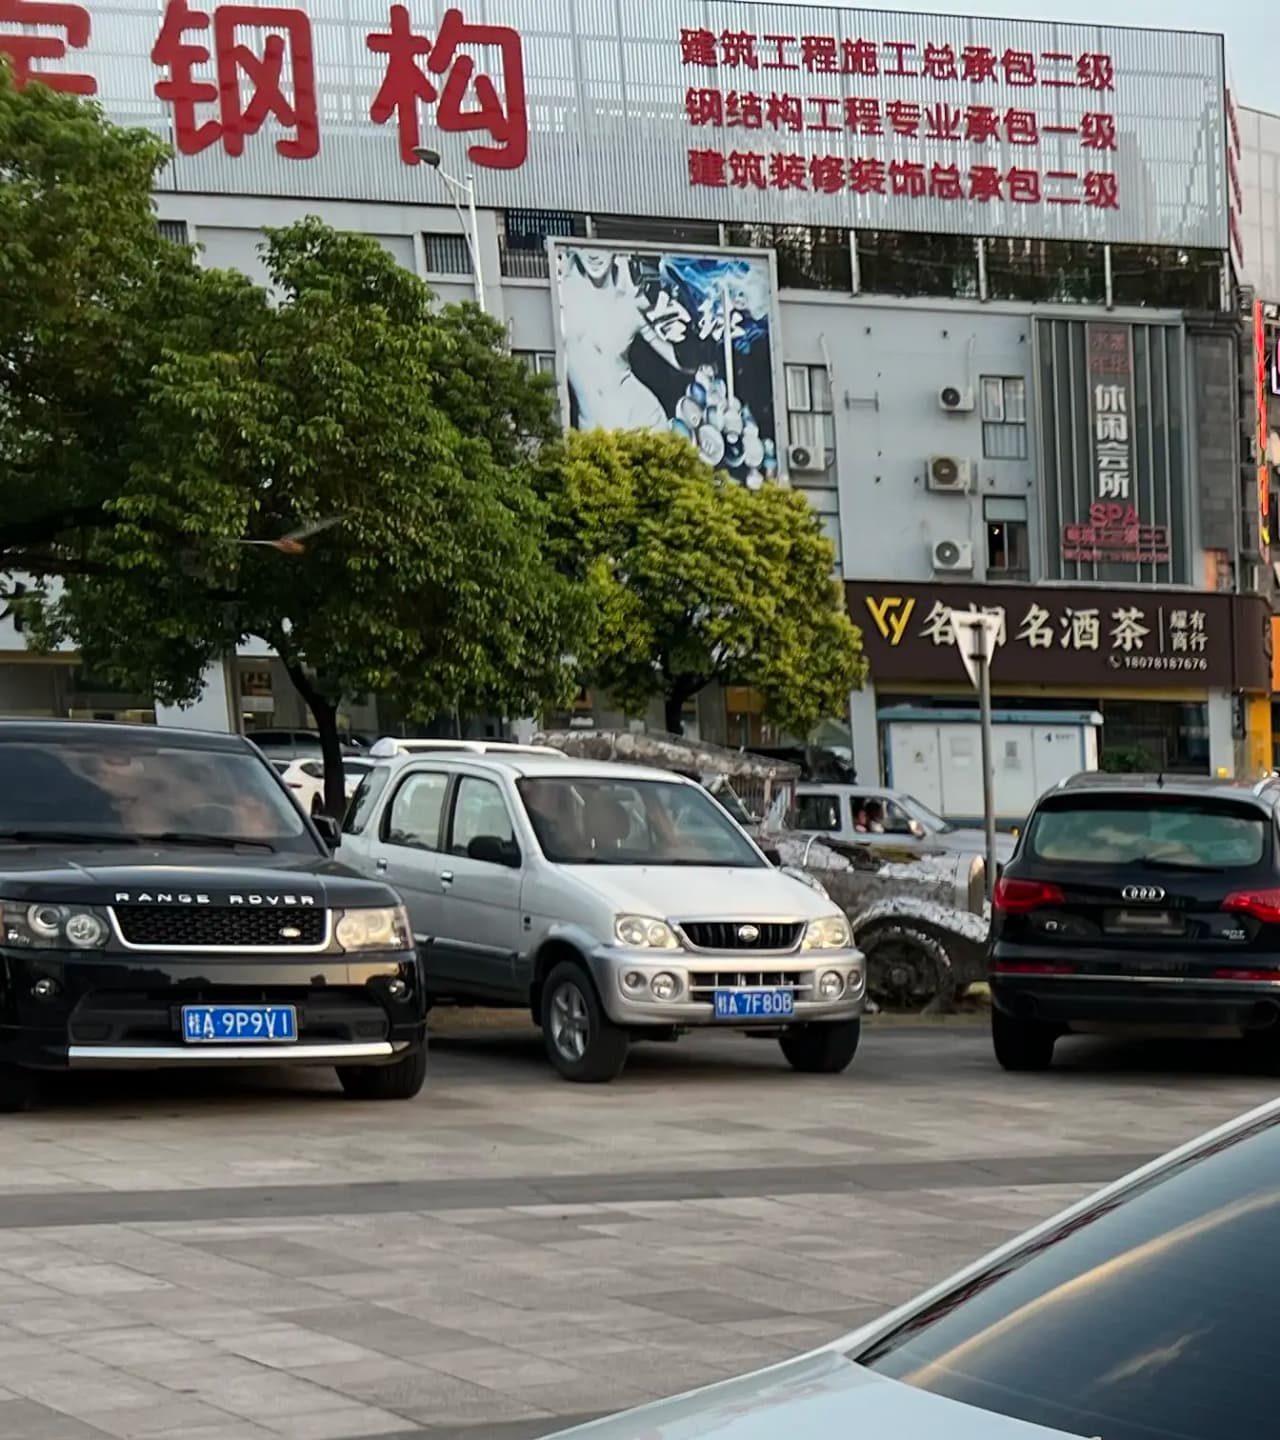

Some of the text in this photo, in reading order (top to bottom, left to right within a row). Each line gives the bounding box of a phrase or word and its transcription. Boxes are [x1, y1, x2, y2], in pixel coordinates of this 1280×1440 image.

[680, 27, 1116, 92] 建筑工程施工总承包二级
[685, 87, 1118, 152] 钢结构工程专业承包一级
[688, 149, 1120, 210] 建筑装修装饰总承包二级
[1095, 384, 1130, 499] 休闲会所
[1089, 503, 1140, 528] SPA
[115, 893, 315, 906] RANGE ROVER
